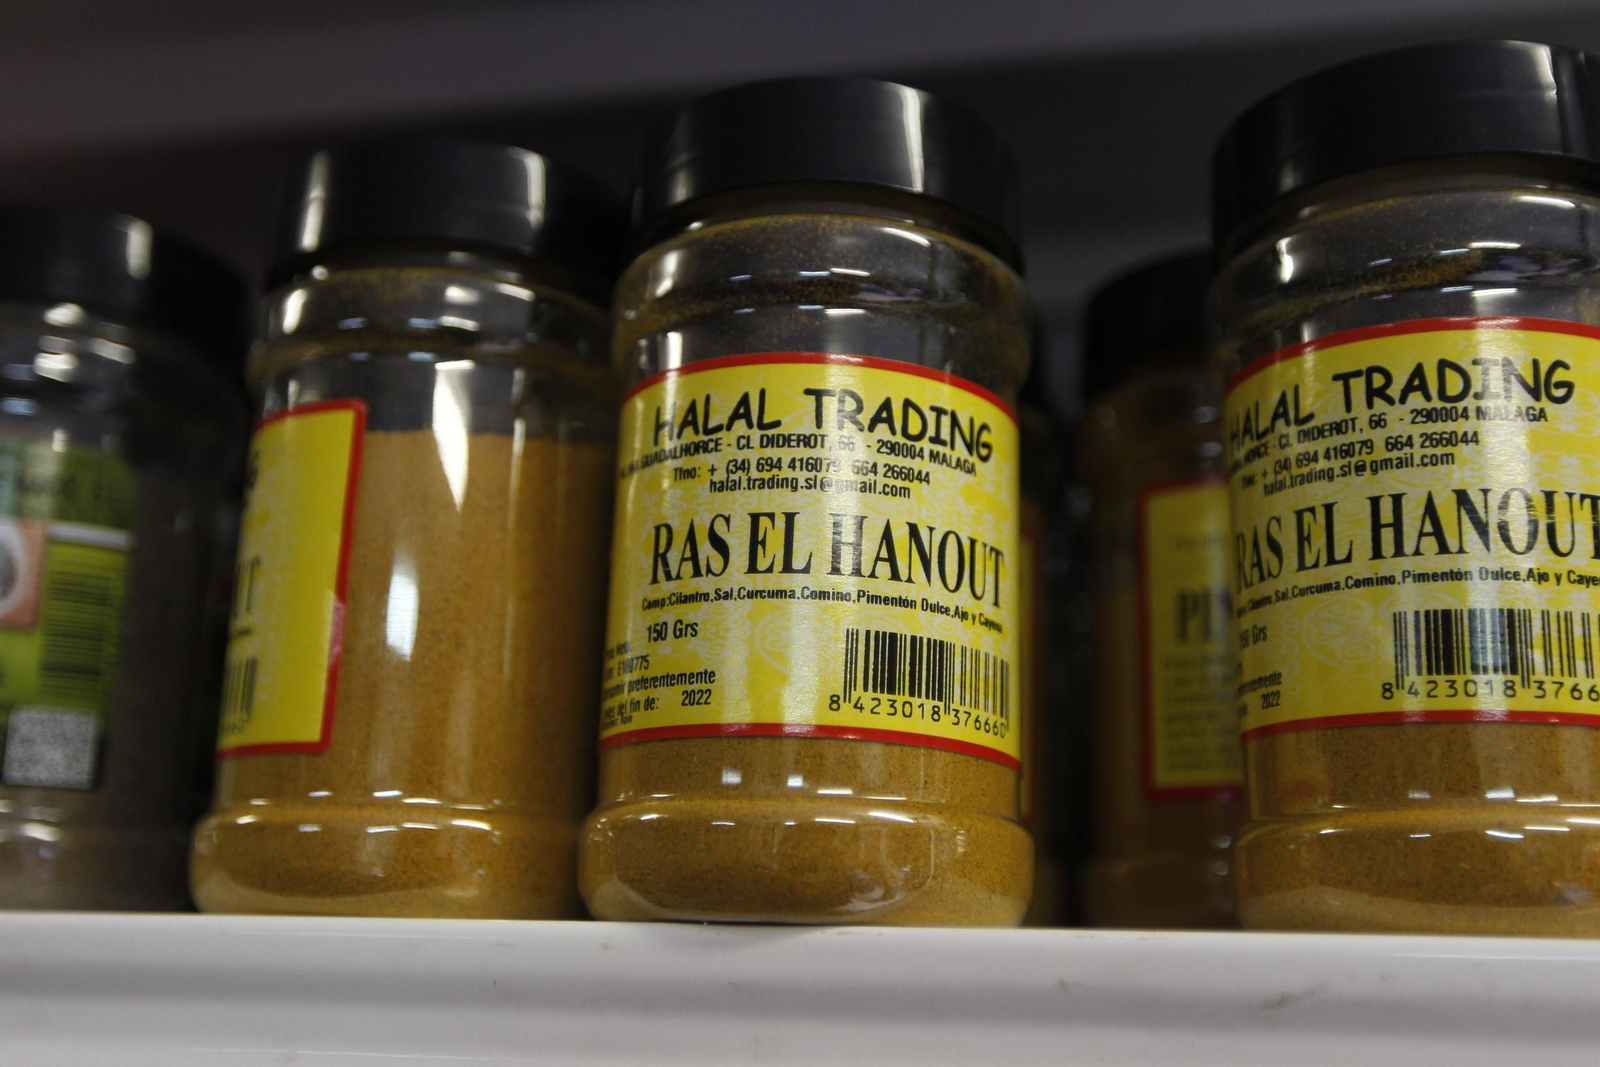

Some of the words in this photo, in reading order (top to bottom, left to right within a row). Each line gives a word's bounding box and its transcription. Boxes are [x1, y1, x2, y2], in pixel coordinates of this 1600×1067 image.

[1230, 383, 1315, 456] HALAL
[1331, 357, 1575, 414] TRADING
[1369, 412, 1387, 430] 66
[1410, 407, 1469, 424] 290004
[653, 388, 782, 446] HALAL
[803, 388, 993, 463] TRADING
[736, 435, 754, 450] CL
[876, 438, 925, 460] 290004
[929, 448, 977, 476] MALAGA
[1296, 450, 1319, 469] 694
[1323, 440, 1374, 462] 416079
[1385, 434, 1414, 452] 664
[1420, 430, 1480, 448] 266044
[726, 458, 750, 477] (34)
[756, 456, 782, 472] 694
[883, 463, 930, 485] 266044
[1236, 515, 1284, 594] RAS
[1294, 501, 1353, 572] EL
[1366, 488, 1600, 560] HANOUT
[649, 513, 731, 585] RAS
[744, 512, 813, 574] EL
[826, 513, 1004, 608] HANOUT
[1567, 569, 1600, 588] Caye
[647, 621, 668, 643] 150
[673, 619, 698, 639] Grs
[1252, 624, 1267, 645] Grs
[627, 668, 716, 697] preferentemente
[1381, 682, 1394, 700] 8
[1407, 680, 1517, 699] 423018
[681, 688, 712, 706] 2022
[829, 694, 841, 711] 8
[853, 696, 941, 722] 423018
[1262, 690, 1281, 710] 2022
